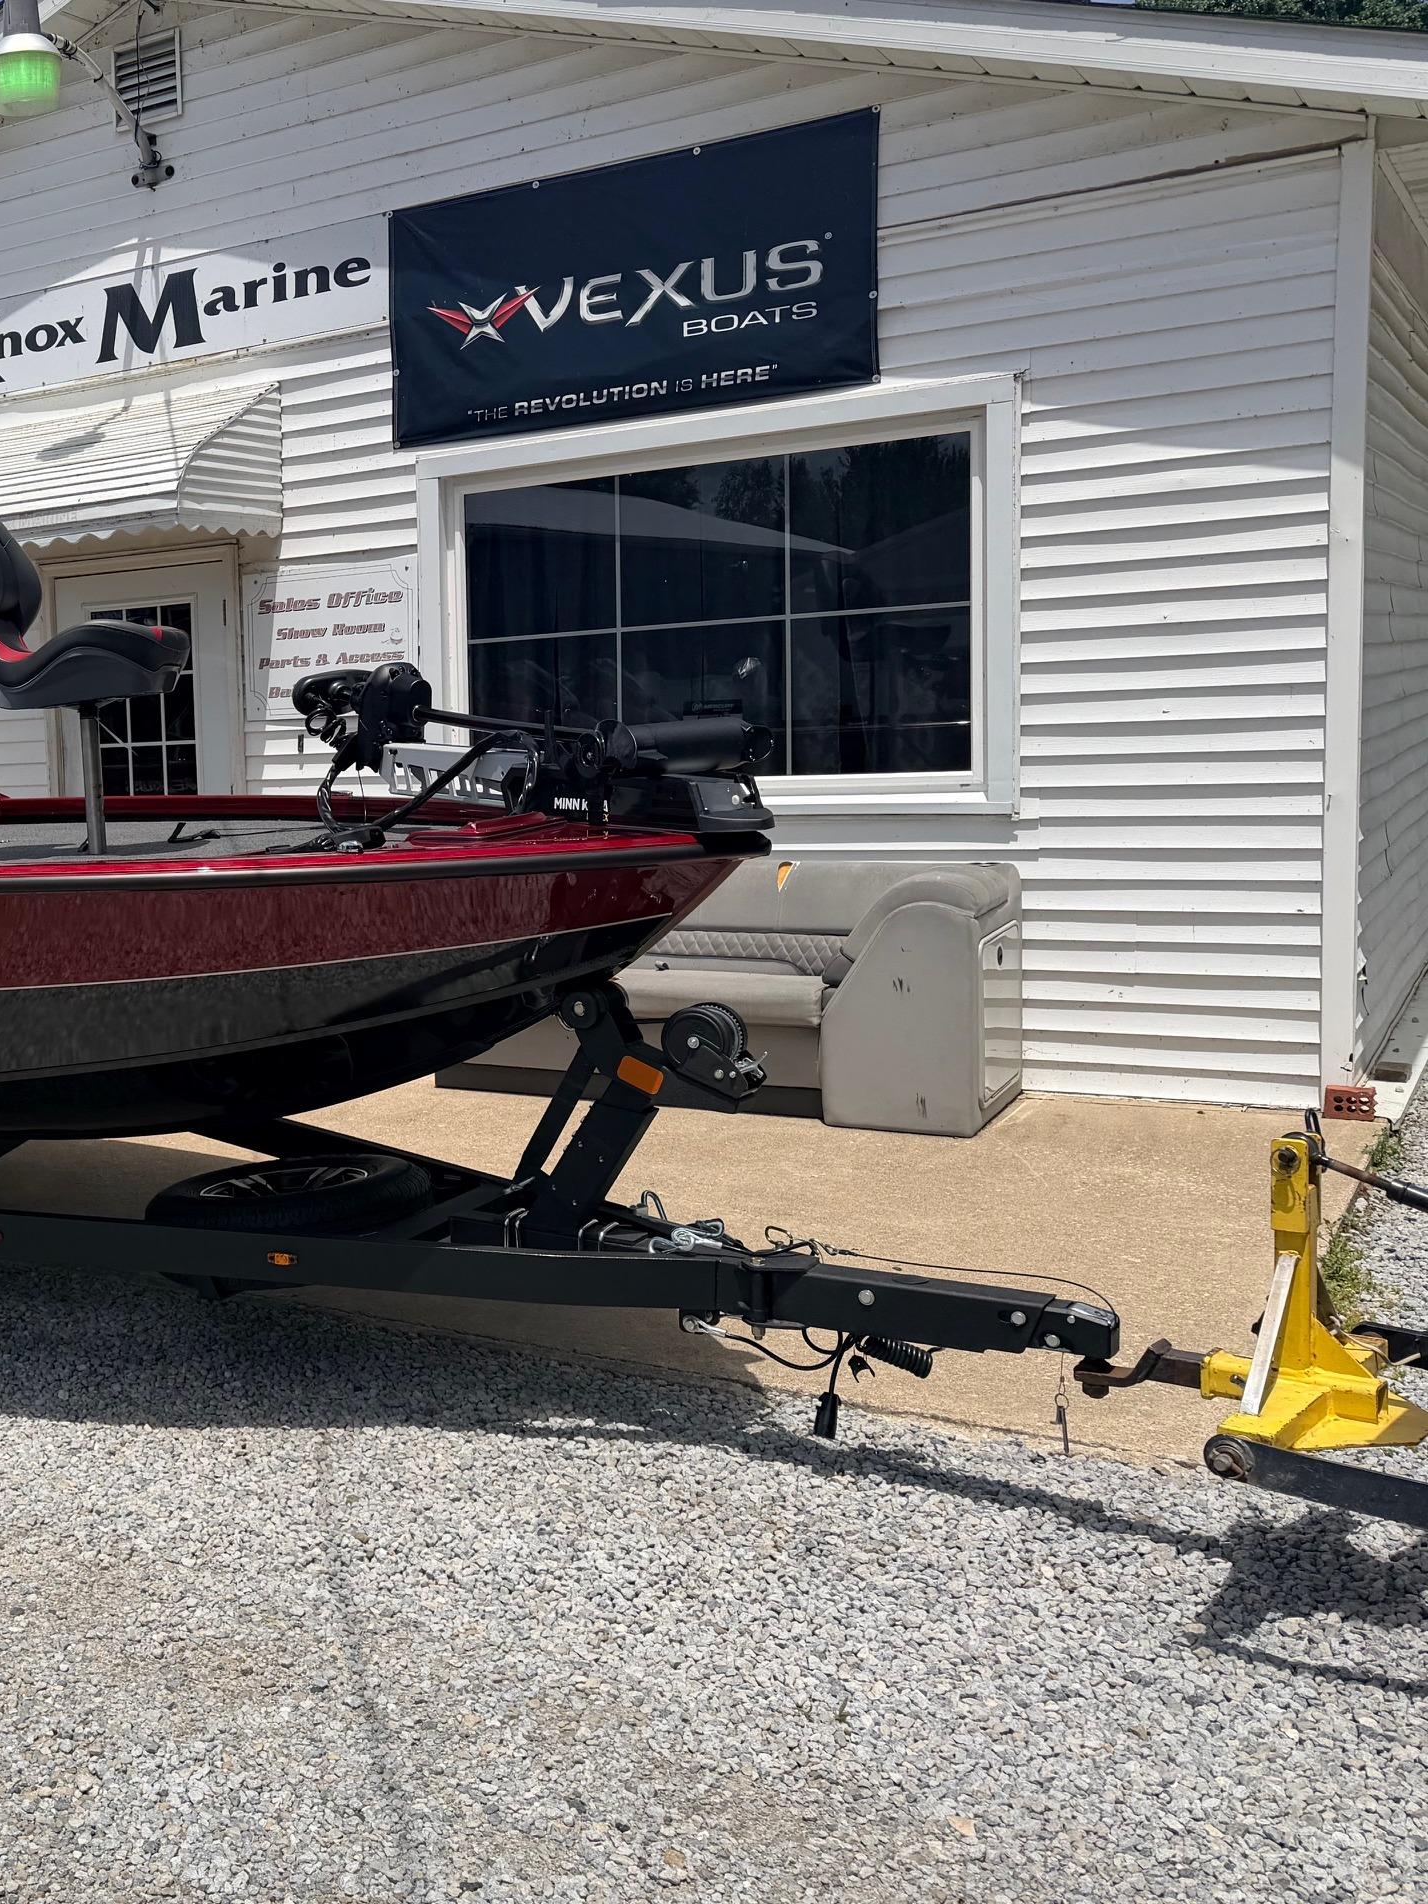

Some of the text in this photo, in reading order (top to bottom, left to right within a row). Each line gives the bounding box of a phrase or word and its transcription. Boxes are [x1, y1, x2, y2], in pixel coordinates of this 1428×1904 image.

[514, 238, 824, 333] VEXUS
[95, 256, 372, 363] Marine
[681, 300, 819, 338] BOATS
[514, 379, 668, 416] REVOLUTION
[675, 378, 693, 393] IS
[257, 587, 404, 615] Sales Office
[275, 621, 386, 641] Show Room
[258, 650, 406, 670] Parts & Access
[553, 796, 609, 813] MINN KA
